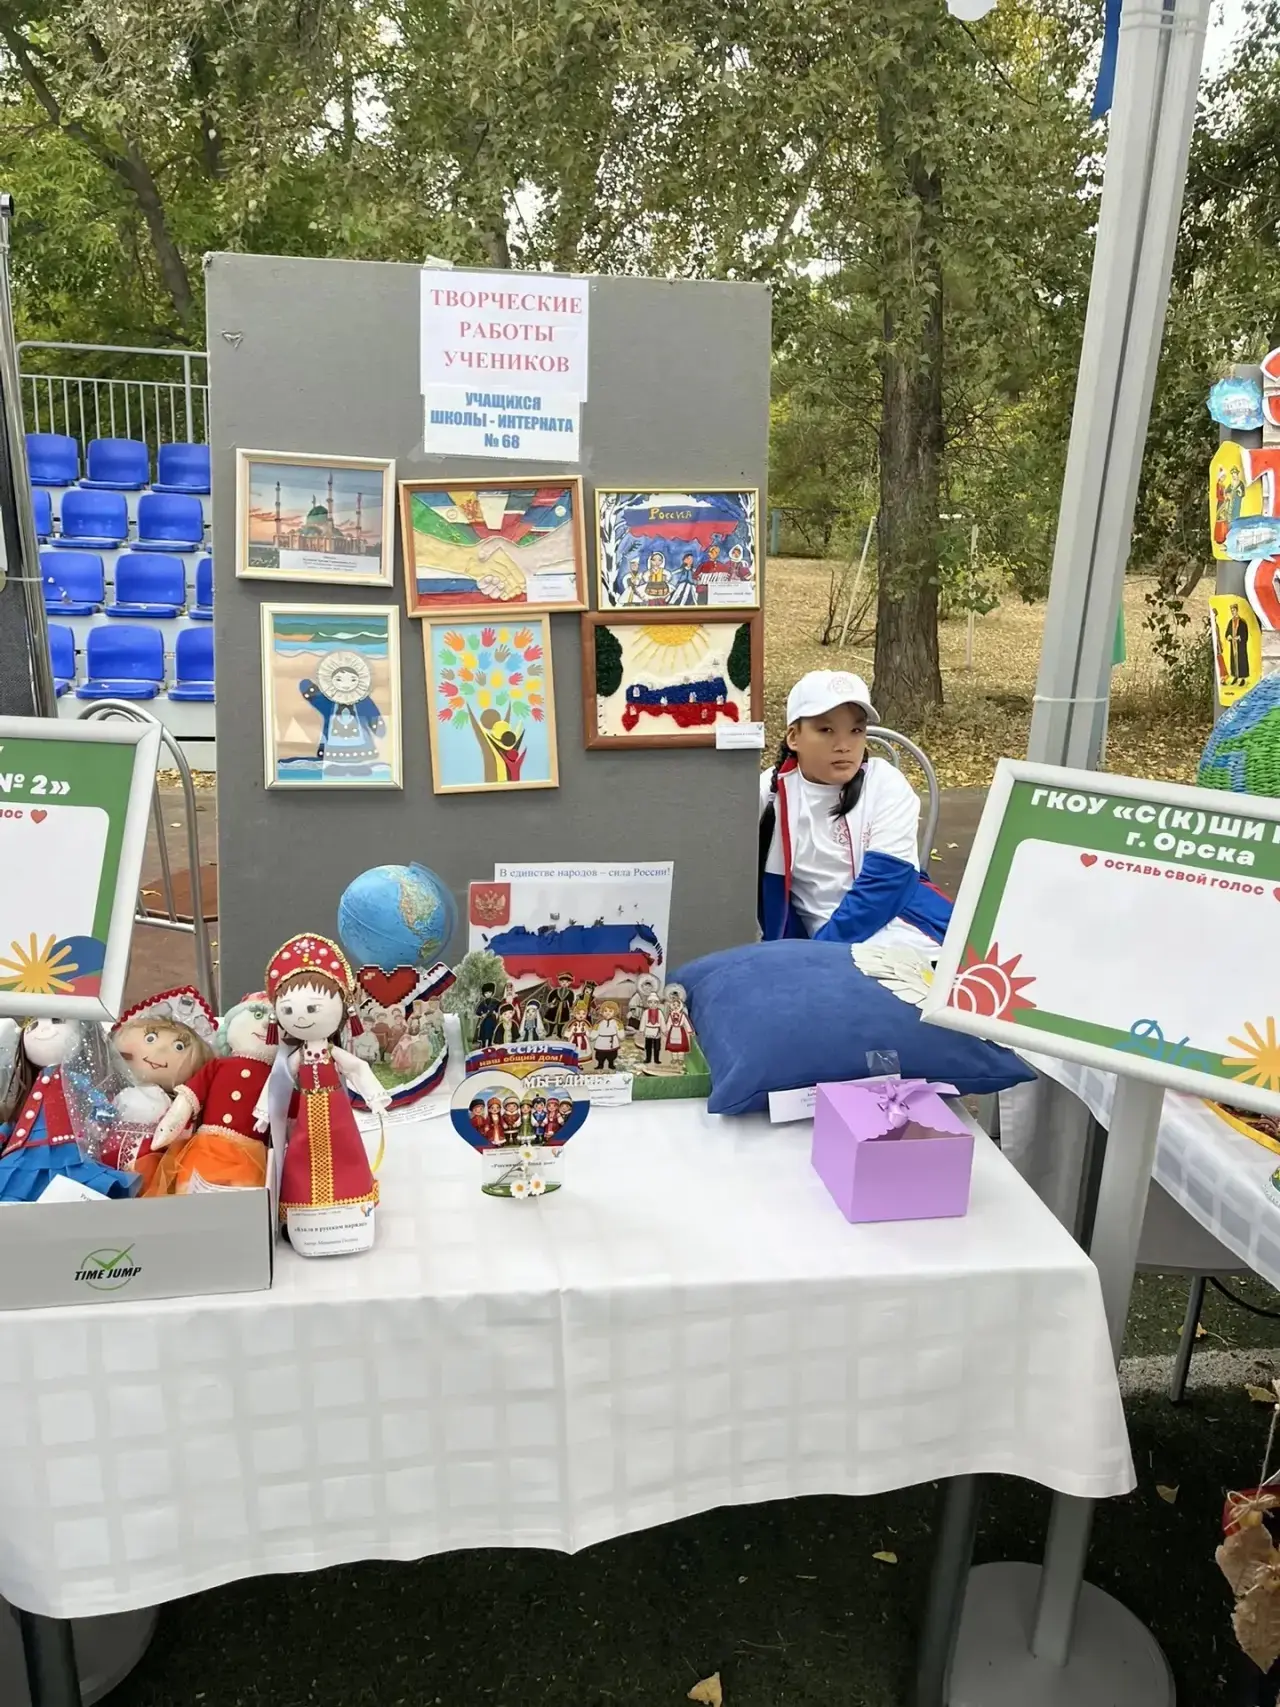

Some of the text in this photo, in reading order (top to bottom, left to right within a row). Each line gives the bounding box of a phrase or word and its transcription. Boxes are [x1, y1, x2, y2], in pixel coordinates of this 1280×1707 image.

[430, 289, 582, 314] ТВОРЧЕСКИЕ
[459, 321, 555, 342] РАБОТЫ
[443, 351, 570, 373] УЧЕНИКОВ
[465, 392, 542, 410] УЧАЩИХСЯ
[430, 410, 487, 427] ШКОЛЫ
[497, 415, 574, 433] ИНТЕРНАТА
[484, 433, 520, 449] № 68
[648, 507, 692, 520] Россия
[30, 774, 71, 795] 2»
[1030, 788, 1108, 815] ГКОУ
[1112, 804, 1266, 841] «С(К)ШИ
[1125, 831, 1146, 848] г.
[1153, 832, 1256, 866] Орска
[499, 868, 507, 877] В
[510, 869, 555, 878] единстве
[557, 869, 597, 879] народов
[608, 869, 631, 877] сила
[633, 867, 671, 877] России!
[1104, 858, 1264, 895] ОСТАВЬ СВОЙ ГОЛОС
[479, 1054, 563, 1067] наш общий дом!
[74, 1266, 142, 1281] TIME JUMP
